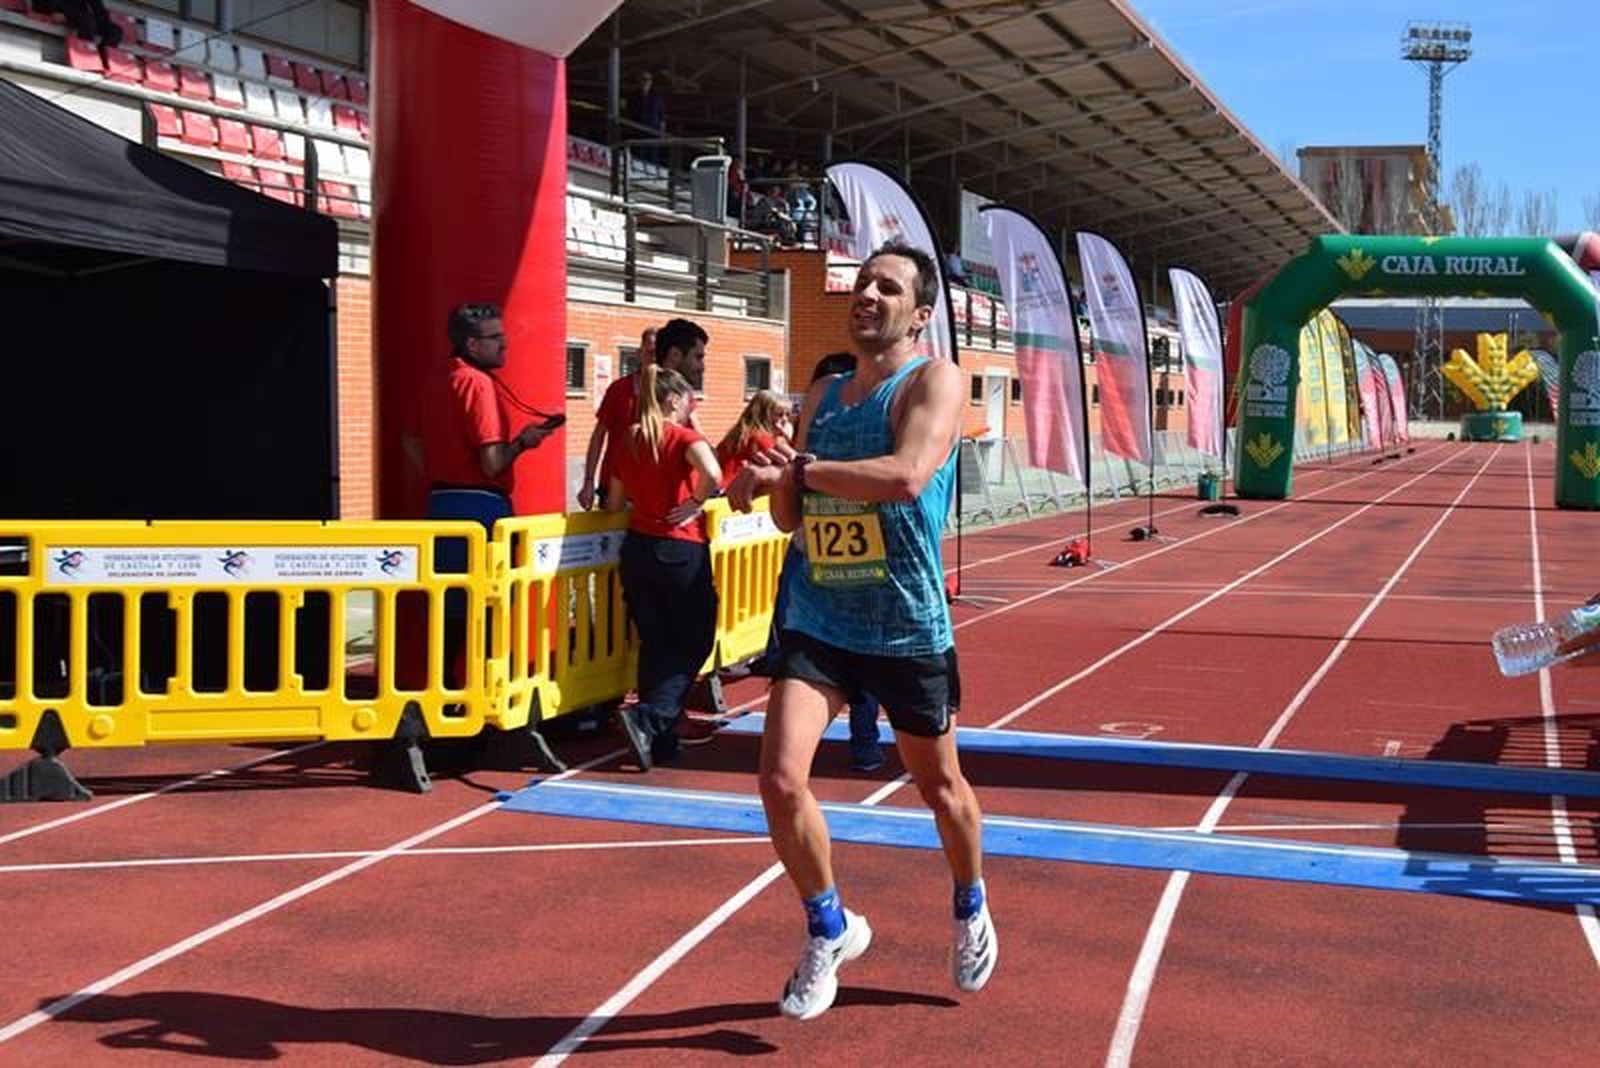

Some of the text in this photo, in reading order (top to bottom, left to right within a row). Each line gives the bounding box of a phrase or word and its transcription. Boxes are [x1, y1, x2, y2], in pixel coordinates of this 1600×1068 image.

[1381, 255, 1526, 276] CAJA RURAL
[811, 521, 869, 557] 123
